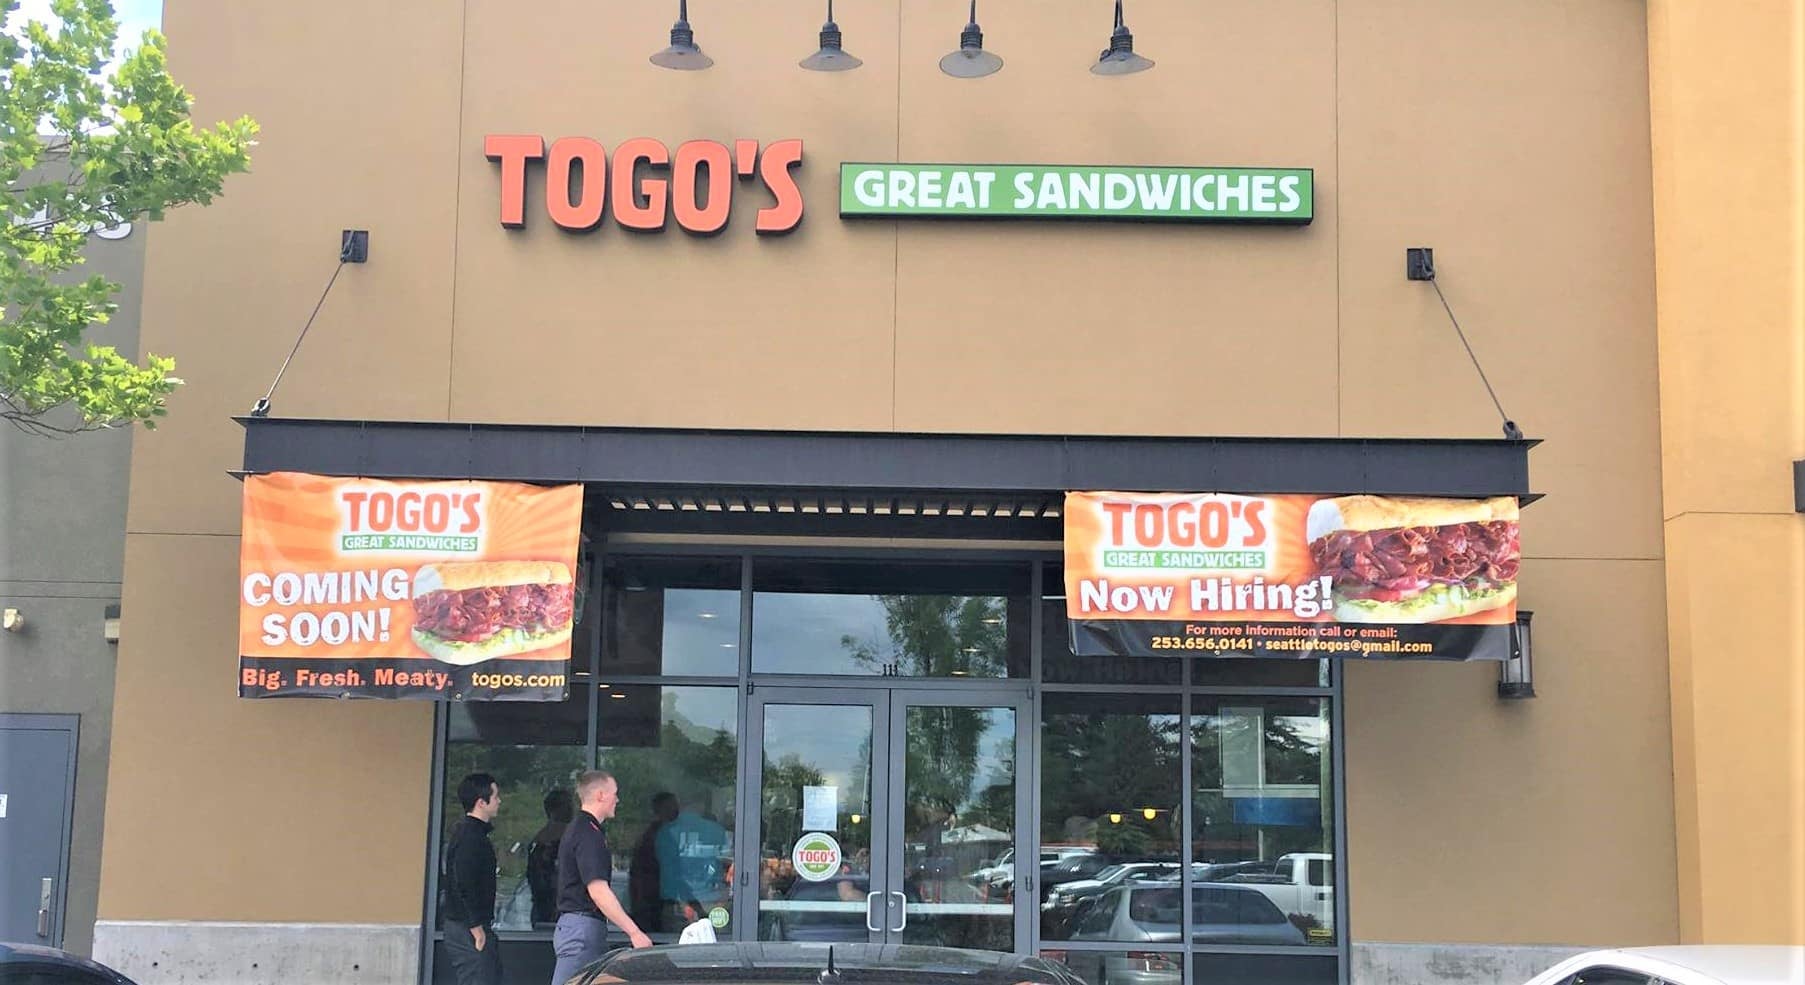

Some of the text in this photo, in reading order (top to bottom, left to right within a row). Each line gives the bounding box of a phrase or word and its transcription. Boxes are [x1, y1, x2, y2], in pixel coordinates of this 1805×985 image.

[484, 133, 804, 236] TOGO'S
[854, 170, 1301, 212] GREAT SANDWICHES
[342, 491, 481, 533] TOGO'S
[1102, 501, 1266, 548] TOGO'S
[344, 536, 477, 551] GREAT SANDWICHES
[1106, 552, 1263, 568] GREAT SANDWICHES
[243, 568, 410, 607] COMING
[1080, 576, 1333, 618] Now Hiring!
[261, 607, 392, 646] SOON!
[1185, 625, 1398, 639] For more information call or email:
[1151, 636, 1433, 654] 253.656.0141 seattletogos@gmail.com
[242, 668, 453, 691] Big. Fresh. Meaty.
[471, 672, 566, 689] togos.com
[798, 850, 836, 863] TOGO'S
